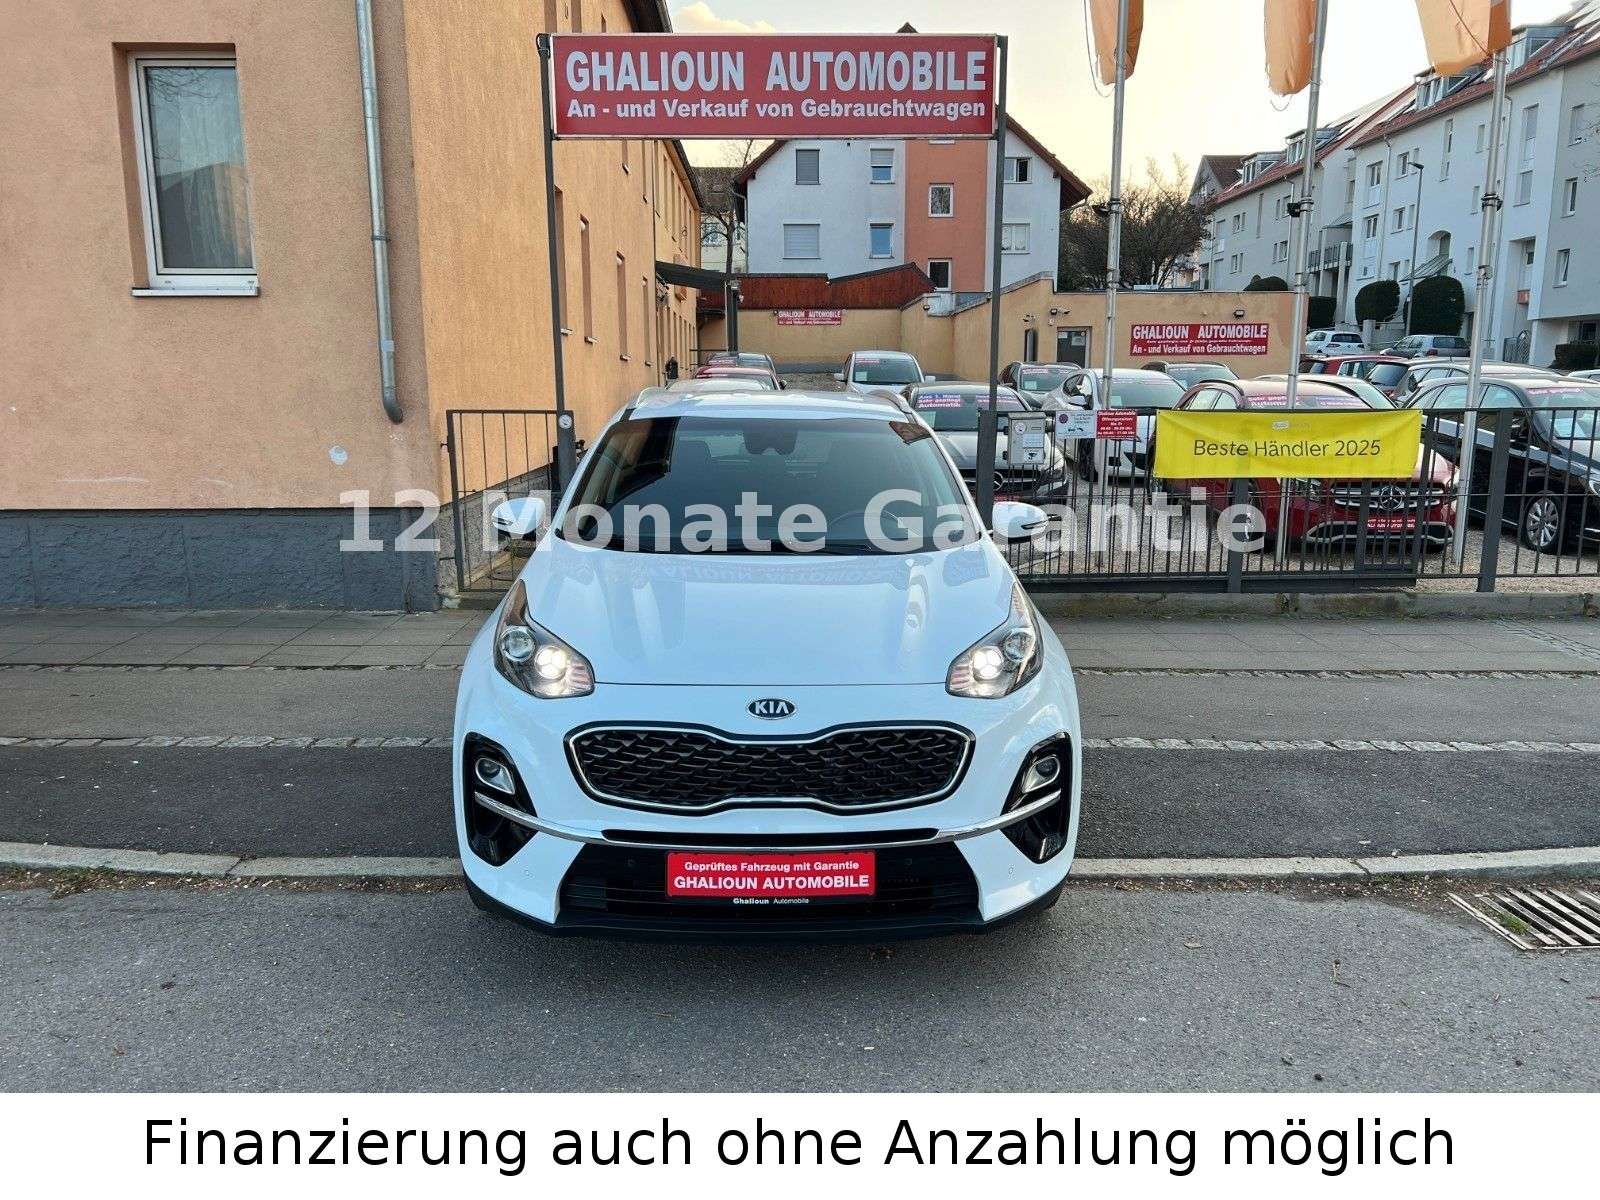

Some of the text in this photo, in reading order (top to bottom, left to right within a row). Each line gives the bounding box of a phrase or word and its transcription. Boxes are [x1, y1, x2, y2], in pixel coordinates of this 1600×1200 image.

[566, 51, 986, 92] GHALIOUN AUTOMOBILE
[567, 99, 596, 118] An
[616, 99, 656, 118] und
[663, 98, 749, 118] Verkauf
[756, 103, 794, 118] von
[801, 99, 985, 121] Gebrauchtwagen
[1132, 324, 1268, 340] GHALIOUN AUTOMOBILE
[1132, 344, 1143, 354] An
[1148, 344, 1162, 354] und
[1163, 344, 1190, 354] Verkauf
[1192, 345, 1205, 353] von
[1206, 343, 1267, 355] Gebrauchtwagen
[1194, 439, 1381, 457] Beste Händler 2025
[755, 701, 789, 714] KIA
[684, 860, 860, 873] Geprüftes Fahrzeug mit Garantie
[674, 875, 870, 890] GHALIOUN AUTOMOBILE
[733, 897, 810, 905] Ghalioun Automobile
